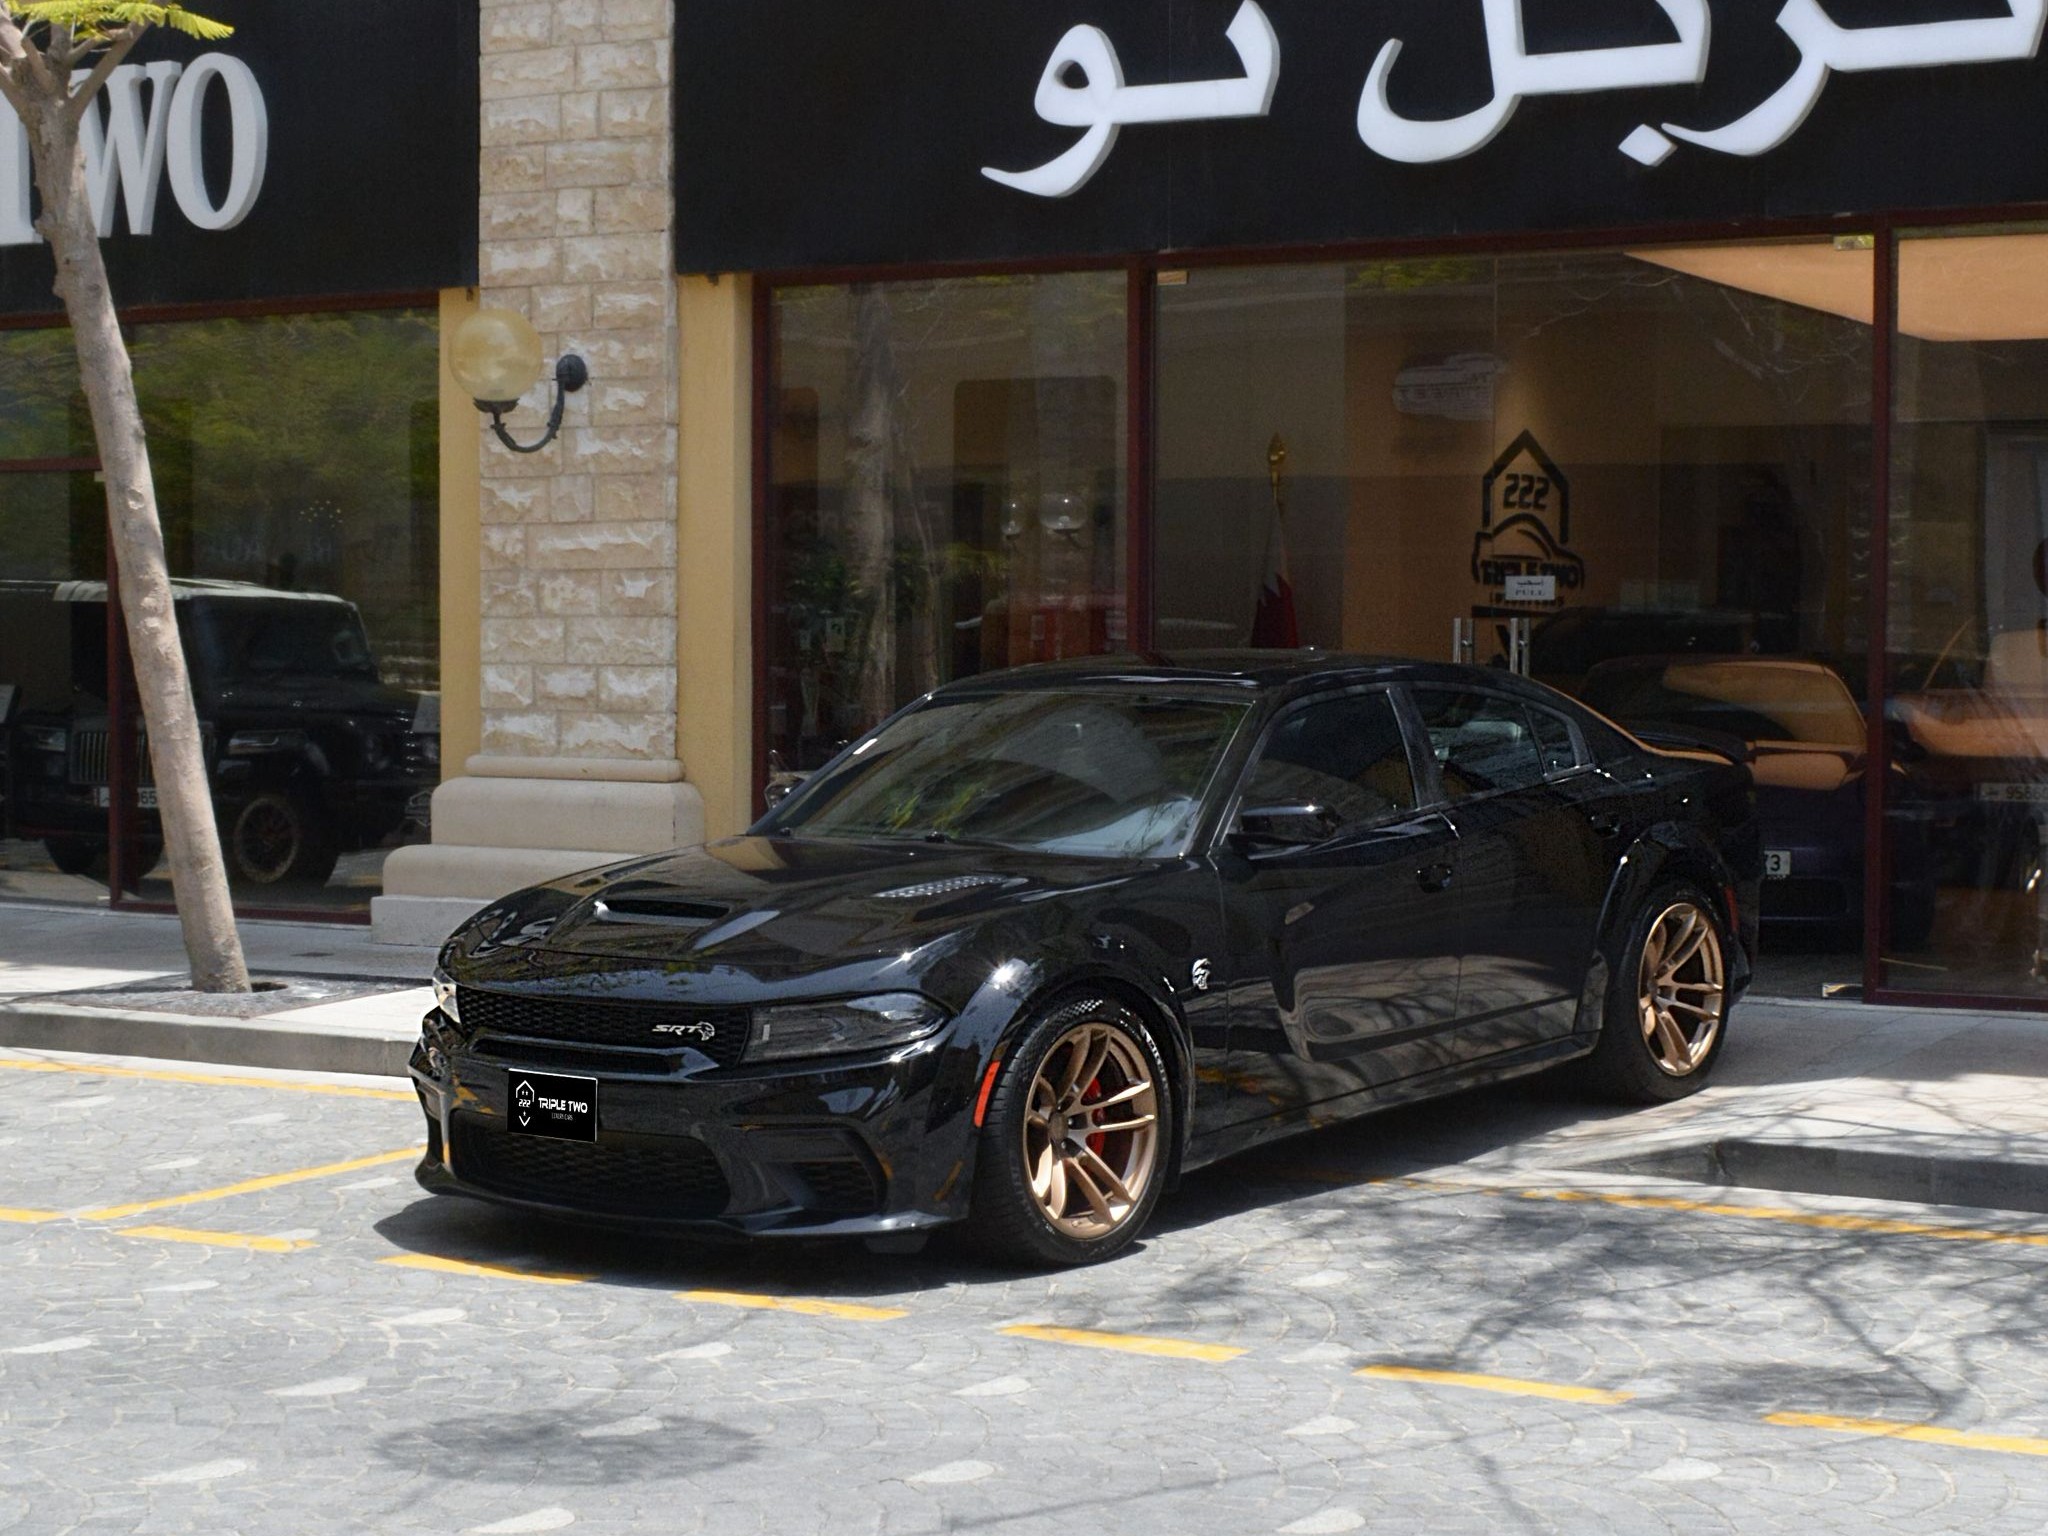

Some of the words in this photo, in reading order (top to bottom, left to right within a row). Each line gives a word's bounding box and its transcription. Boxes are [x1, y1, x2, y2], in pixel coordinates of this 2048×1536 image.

[1515, 589, 1546, 597] PULL
[651, 1024, 701, 1036] SRT
[518, 1098, 531, 1108] 222
[537, 1096, 567, 1111] TRIPLE
[567, 1100, 588, 1114] TWO
